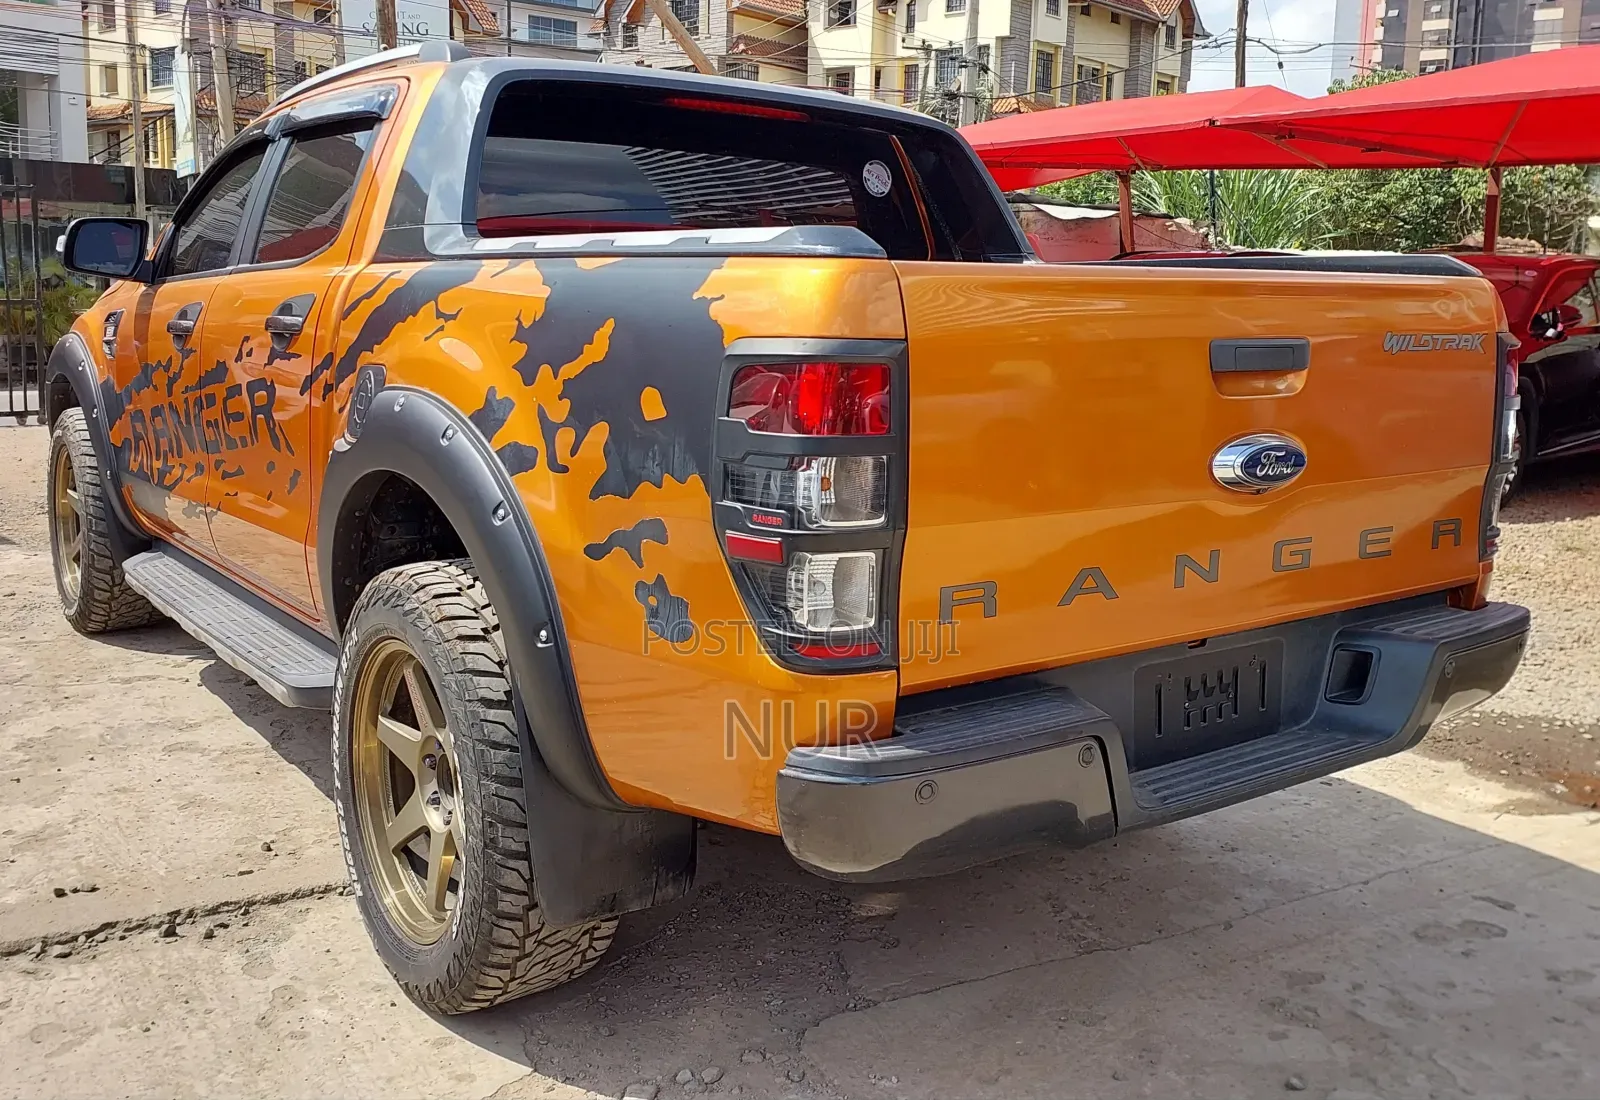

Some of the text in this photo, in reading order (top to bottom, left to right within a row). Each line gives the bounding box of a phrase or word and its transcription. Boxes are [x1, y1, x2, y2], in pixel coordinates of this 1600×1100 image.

[1383, 331, 1488, 354] WILDTRAK
[1256, 450, 1295, 477] Ford
[752, 513, 783, 526] RANGER
[938, 518, 1462, 625] RANGER
